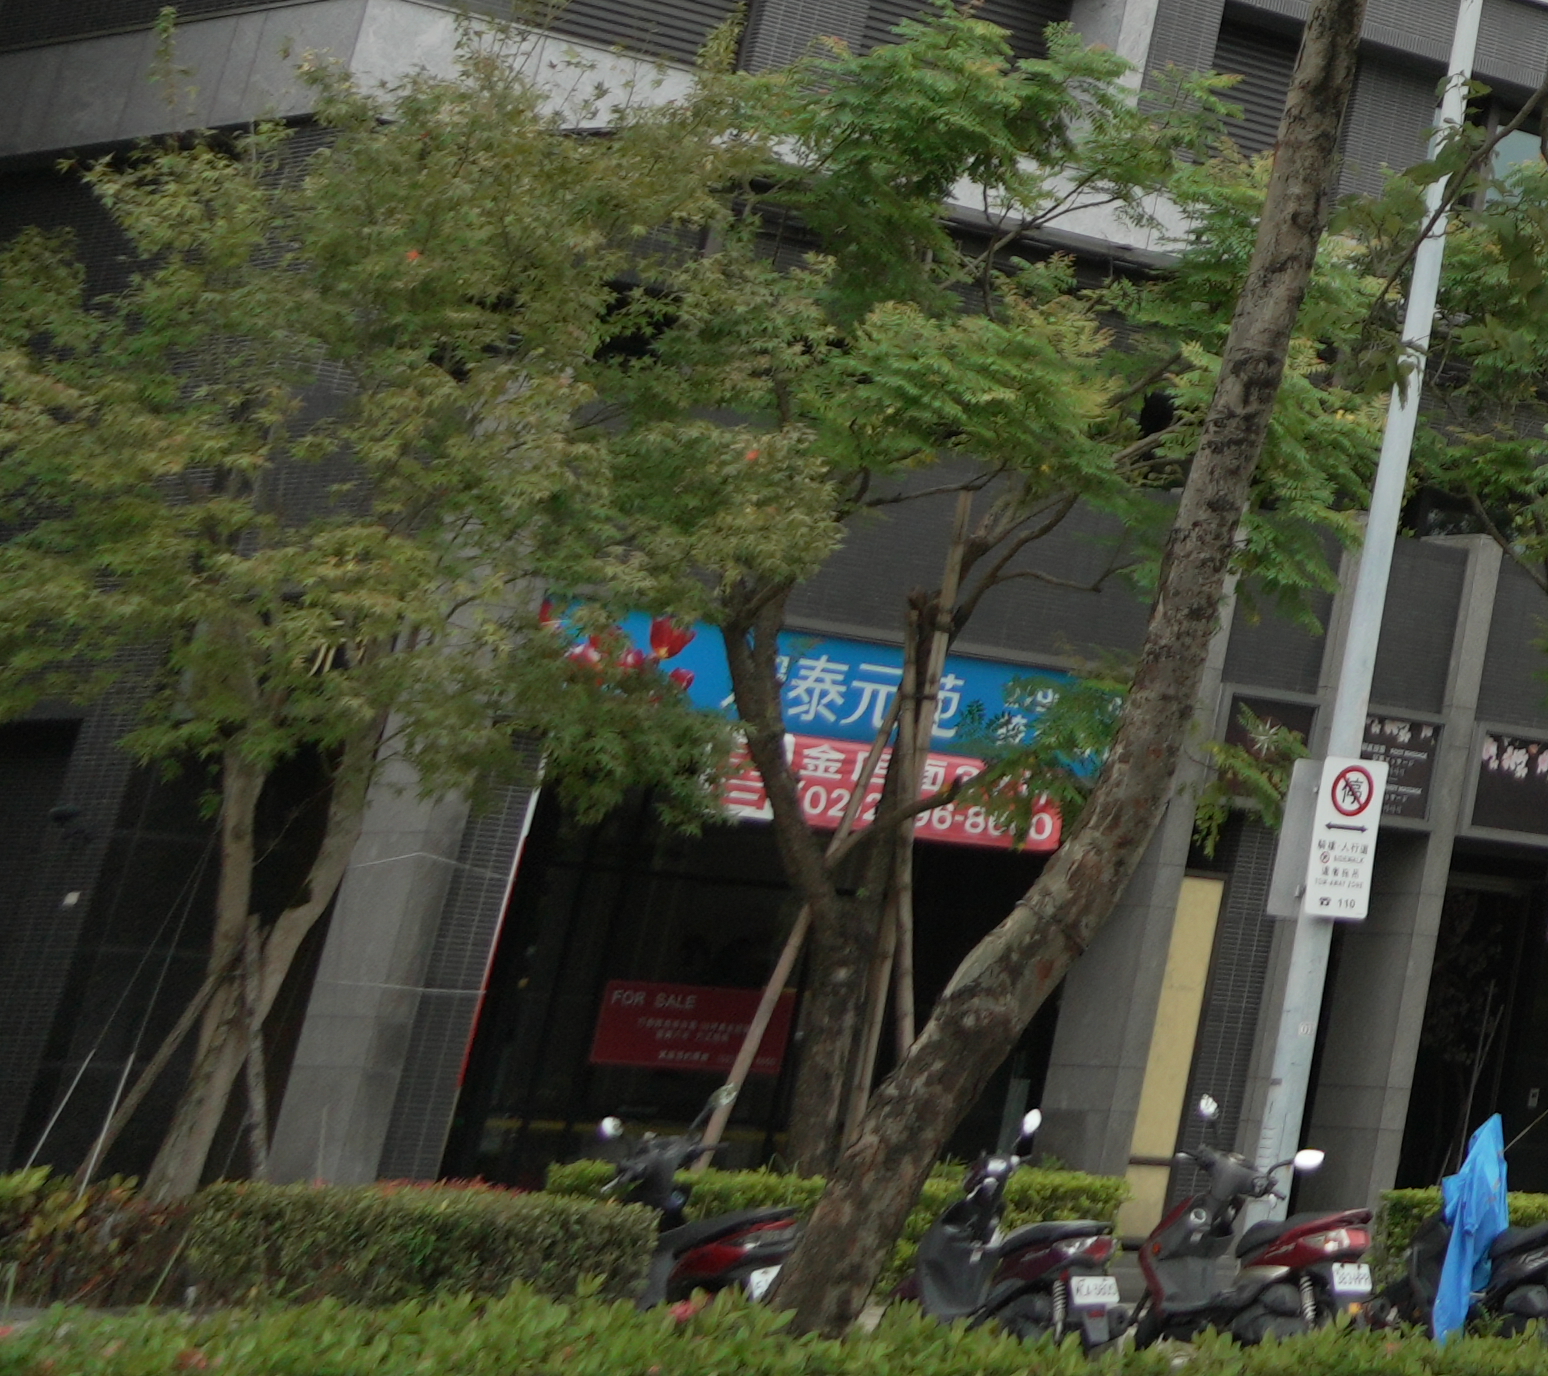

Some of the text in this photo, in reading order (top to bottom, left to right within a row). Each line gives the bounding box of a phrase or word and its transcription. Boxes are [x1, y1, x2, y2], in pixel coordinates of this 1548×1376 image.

[720, 653, 967, 739] 泰元苑
[1338, 898, 1356, 909] 110
[611, 989, 697, 1009] FOR SALE
